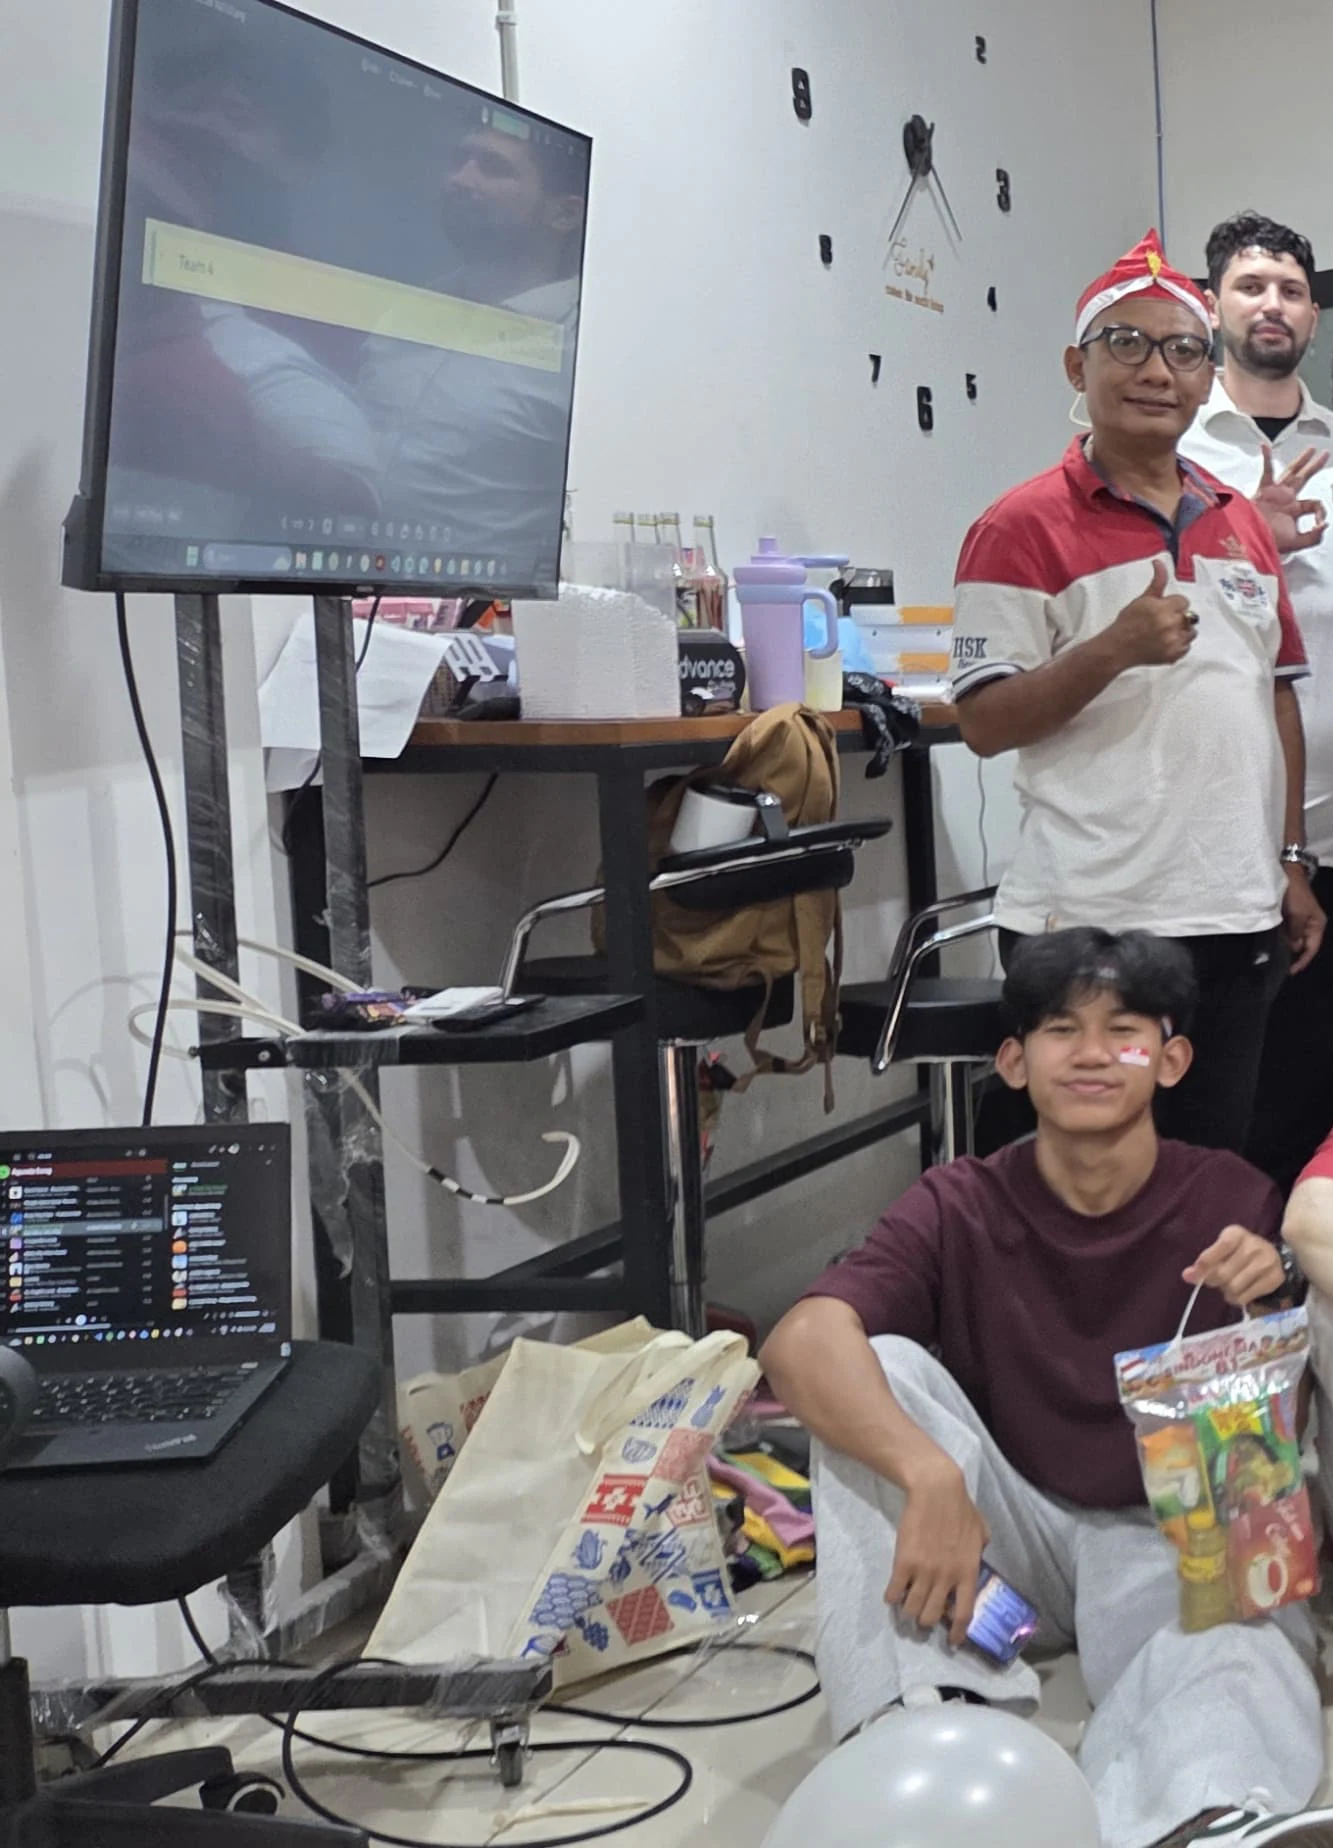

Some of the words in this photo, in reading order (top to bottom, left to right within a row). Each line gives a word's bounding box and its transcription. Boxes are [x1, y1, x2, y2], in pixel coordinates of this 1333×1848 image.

[996, 168, 1010, 212] 3
[869, 354, 881, 382] 7
[965, 373, 977, 399] 5
[917, 386, 933, 431] 6
[679, 653, 736, 680] dvance
